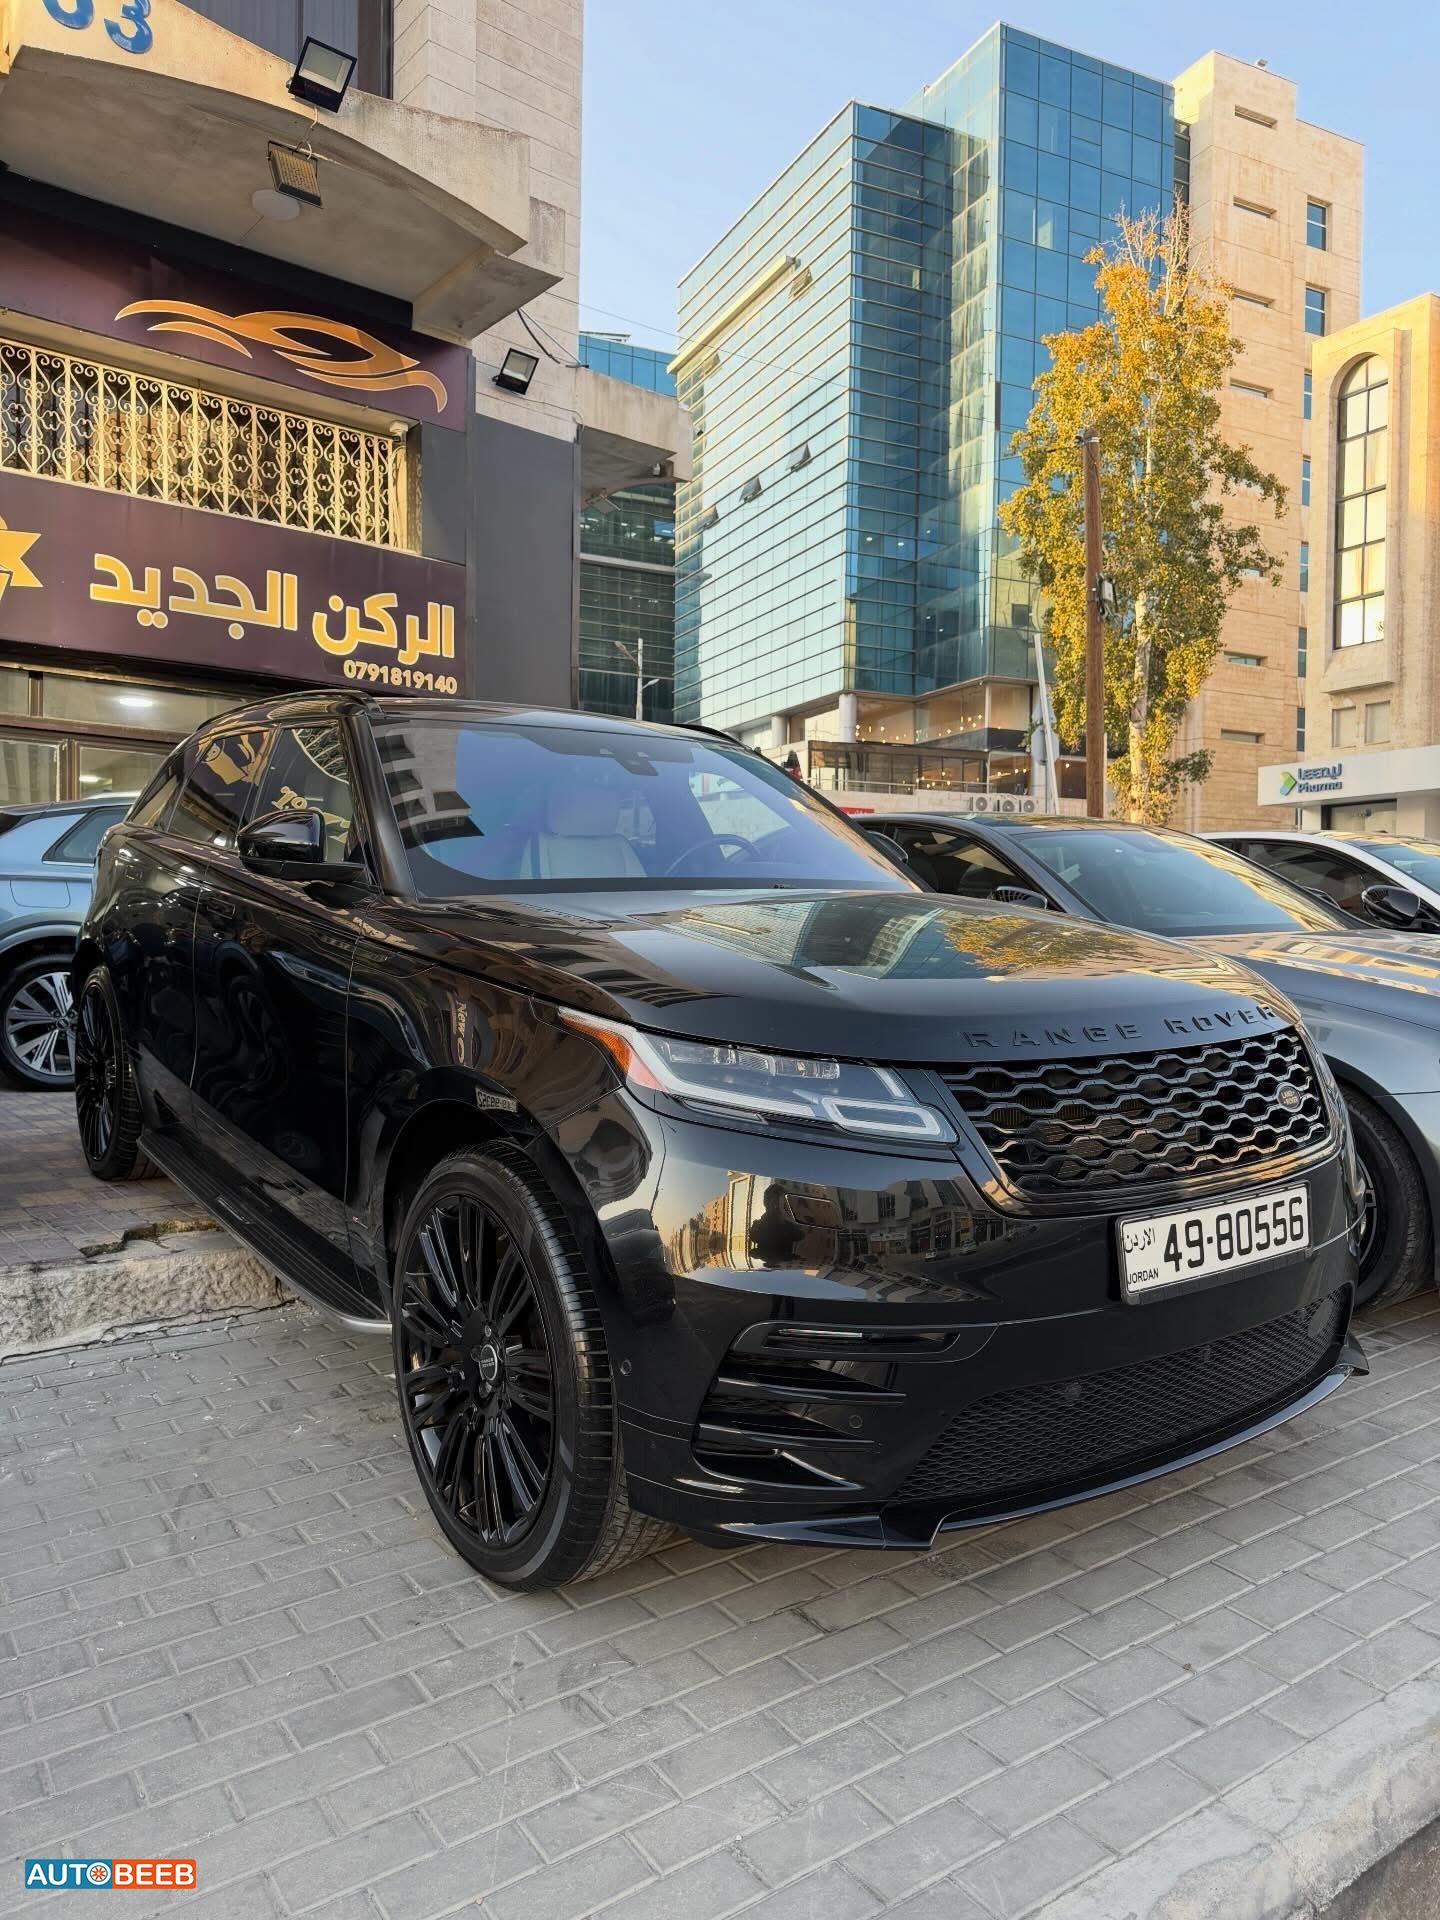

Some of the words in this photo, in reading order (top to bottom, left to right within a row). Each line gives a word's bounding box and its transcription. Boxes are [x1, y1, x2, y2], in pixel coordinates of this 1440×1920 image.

[90, 553, 298, 640] الجديد
[312, 593, 455, 665] الركن
[343, 659, 458, 695] 0791819140
[1298, 781, 1343, 793] Pharma
[960, 1022, 1144, 1048] RANGE
[1163, 1005, 1277, 1034] ROVER
[1163, 1196, 1304, 1272] 49-80556
[1127, 1267, 1159, 1285] JORDAN
